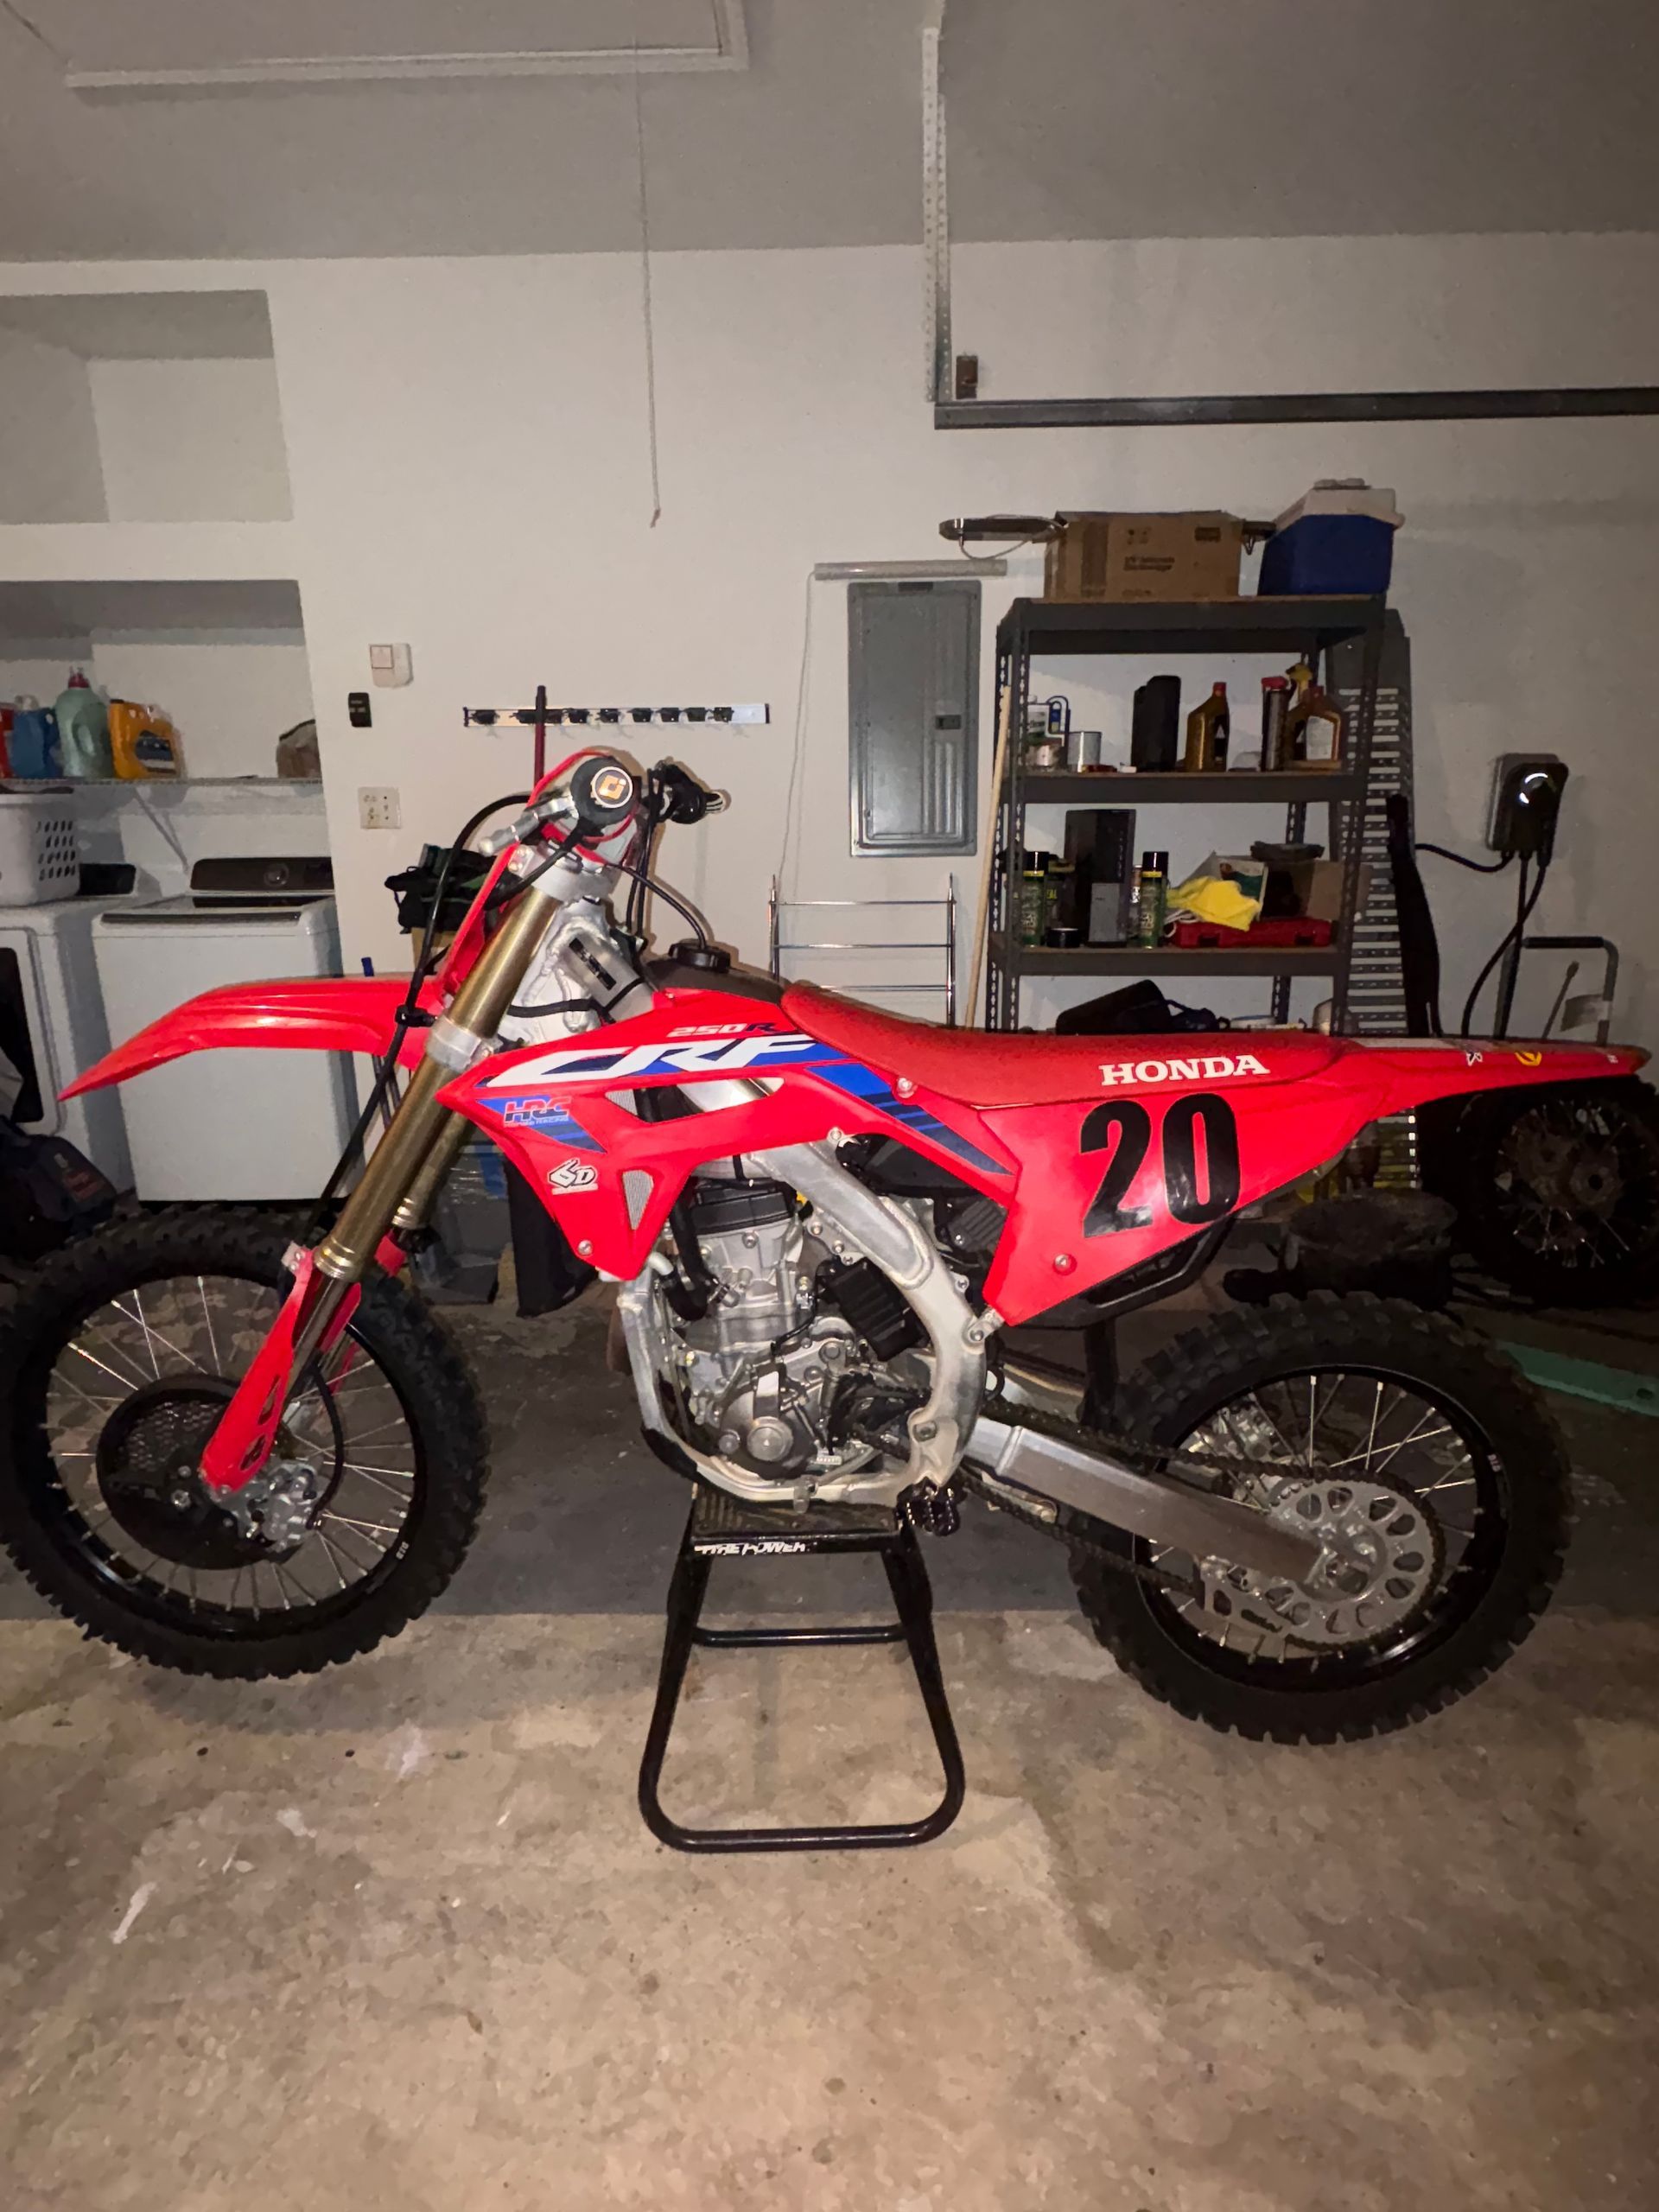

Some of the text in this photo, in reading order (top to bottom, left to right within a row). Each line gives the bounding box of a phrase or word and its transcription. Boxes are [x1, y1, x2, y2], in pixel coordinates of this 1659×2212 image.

[667, 1022, 775, 1038] 250R
[485, 1033, 817, 1088] CRF
[1099, 1055, 1269, 1086] HONDA
[504, 1096, 572, 1122] HRC
[1080, 1092, 1241, 1238] 20
